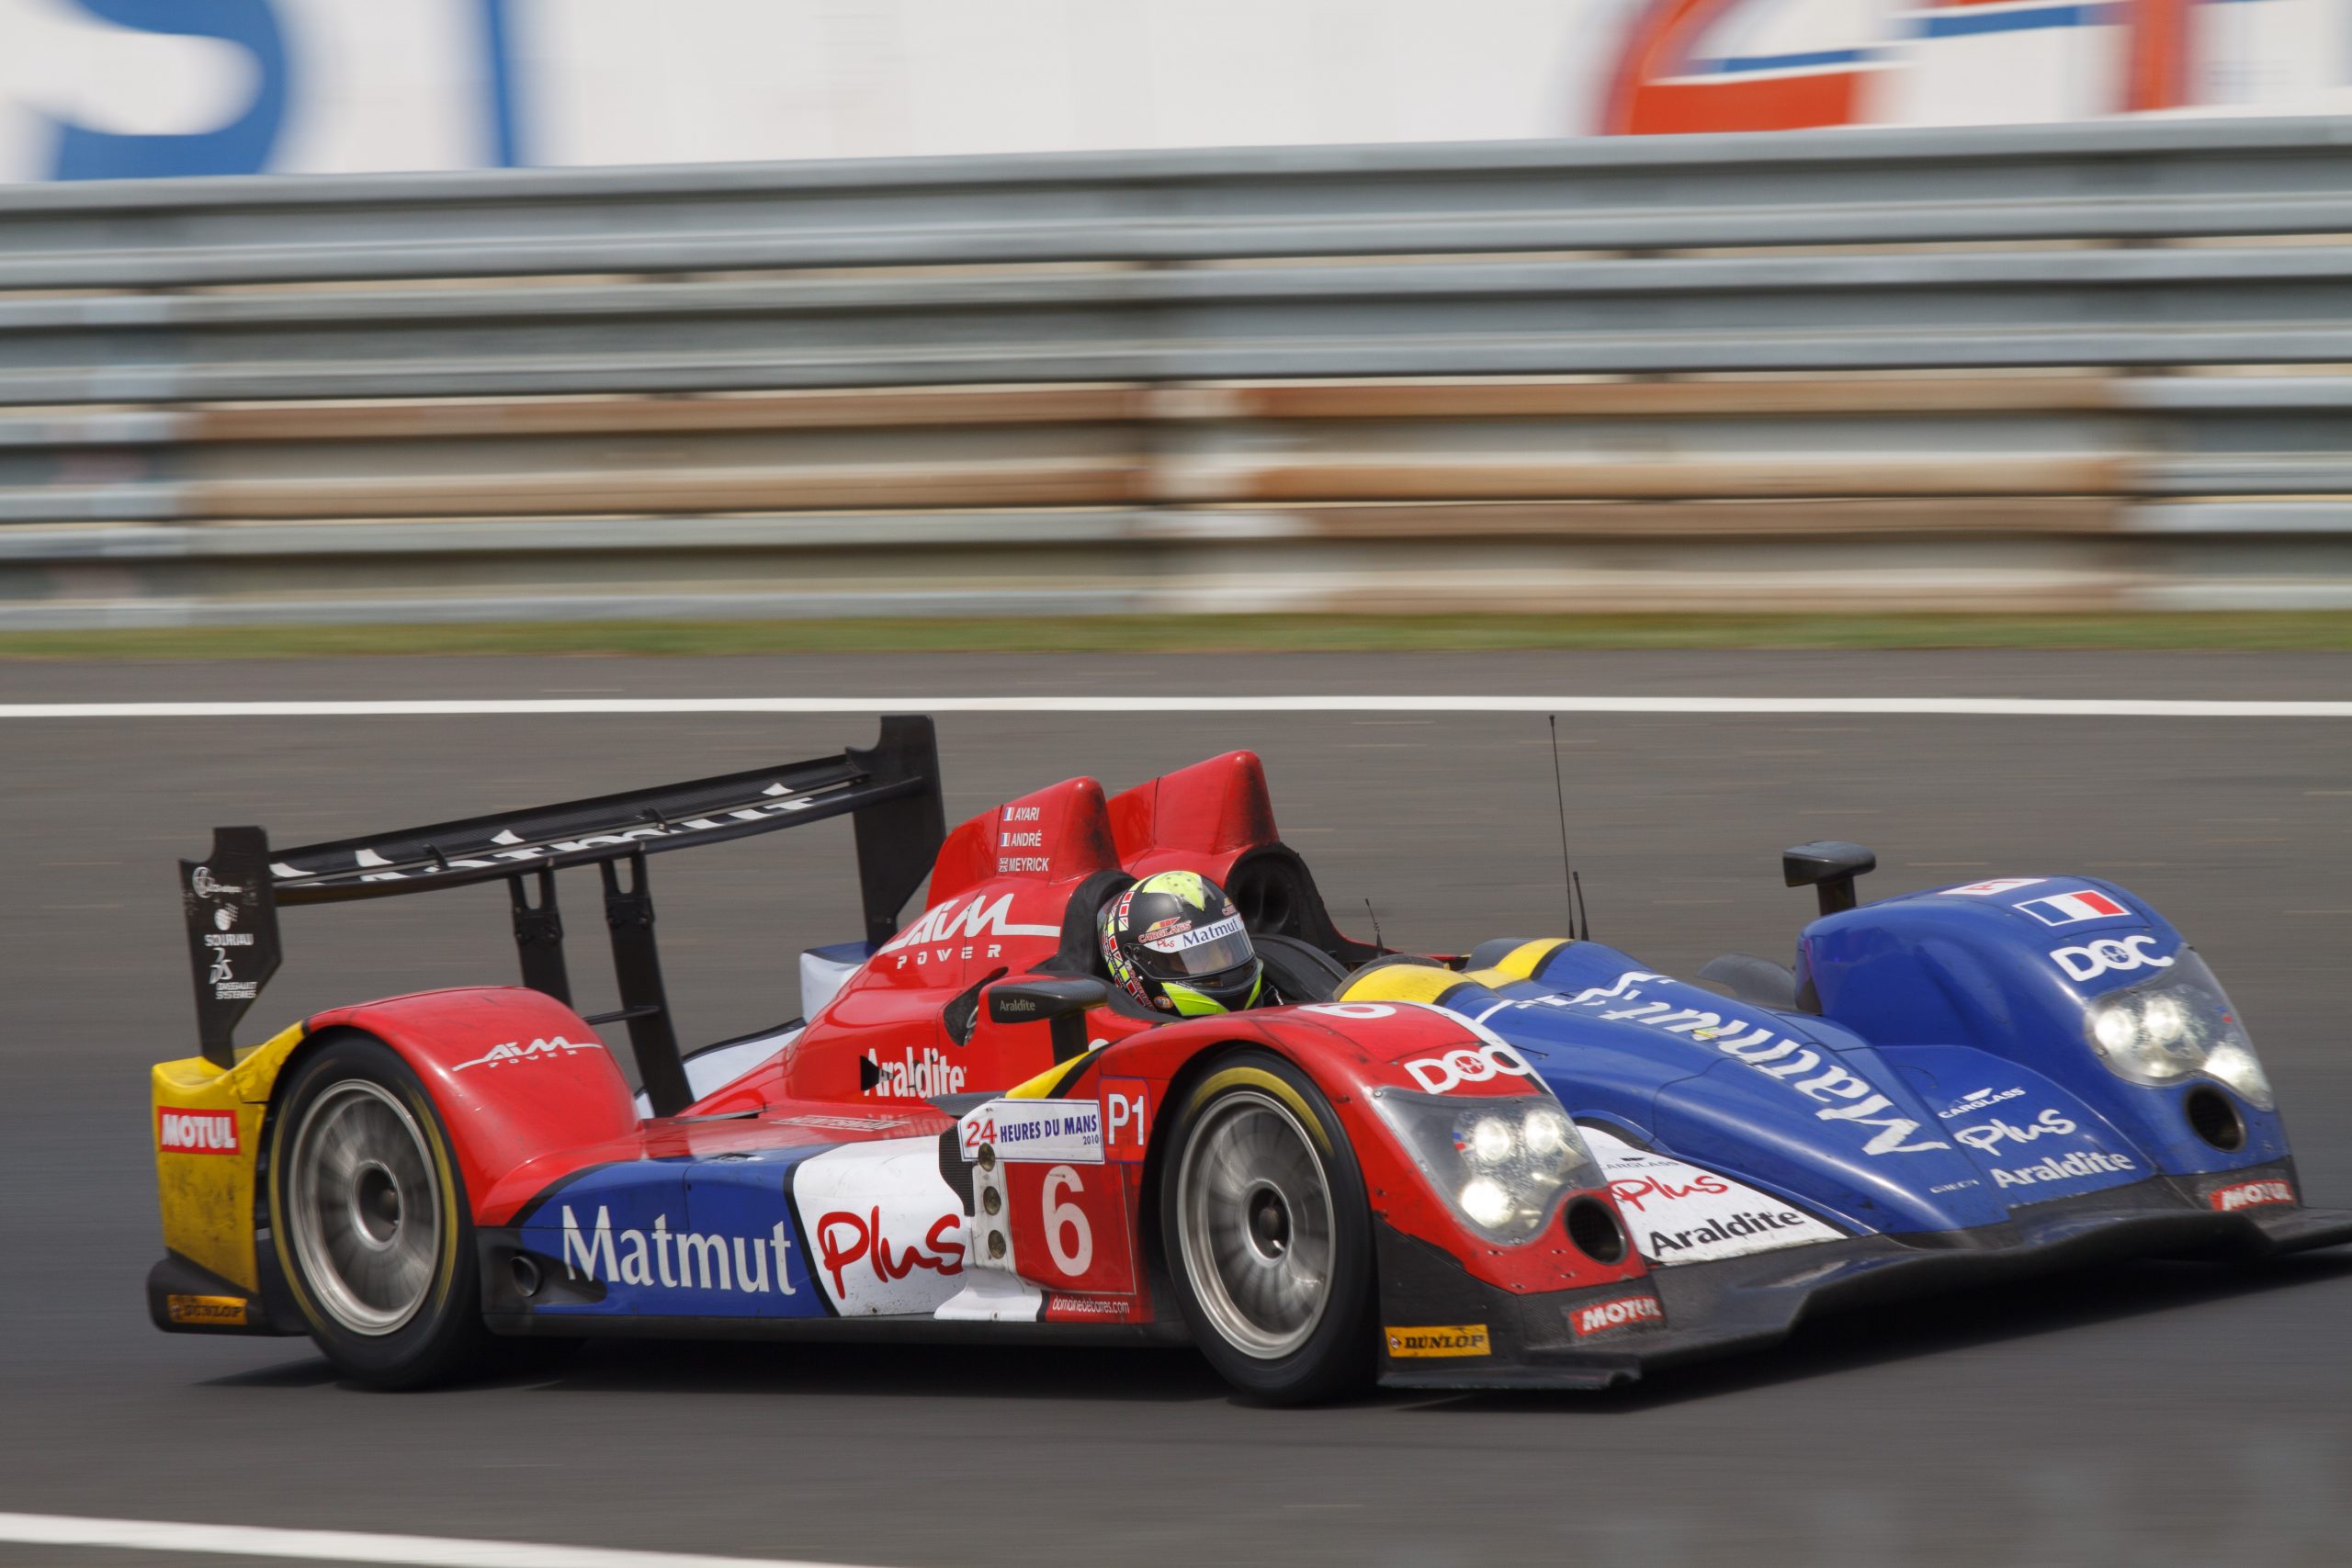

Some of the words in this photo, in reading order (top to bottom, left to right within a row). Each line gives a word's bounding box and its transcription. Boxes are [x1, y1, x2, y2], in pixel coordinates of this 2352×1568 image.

[1014, 807, 1040, 821] AYARI
[1011, 829, 1042, 846] ANDRÉ
[1009, 858, 1049, 872] MEYRICK
[1138, 920, 1192, 943] CARGLASS
[1182, 919, 1238, 947] Matmut
[897, 944, 1001, 969] POWER
[2049, 935, 2175, 982] DOC
[1000, 999, 1035, 1011] Araldite
[865, 1046, 966, 1098] Araldite
[1598, 1002, 1951, 1156] Matmut
[1108, 1093, 1144, 1146] P1
[1938, 1088, 2027, 1118] CARGLASS
[161, 1114, 236, 1148] MOTUL
[966, 1118, 998, 1147] 24
[1000, 1120, 1040, 1143] HEURES
[1045, 1118, 1060, 1137] DU
[1064, 1114, 1097, 1135] MANS
[1083, 1134, 1099, 1145] 2010
[1953, 1109, 2077, 1157] Plus
[1990, 1152, 2136, 1189] Araldite
[1608, 1175, 1728, 1212] Plus
[2222, 1182, 2293, 1211] MOTUL
[1042, 1165, 1092, 1277] 6
[1649, 1212, 1805, 1258] Araldite
[562, 1205, 796, 1295] Matmut
[817, 1205, 967, 1300] Plus
[1582, 1297, 1661, 1331] MOTUL
[1405, 1335, 1484, 1348] DUNLOP
